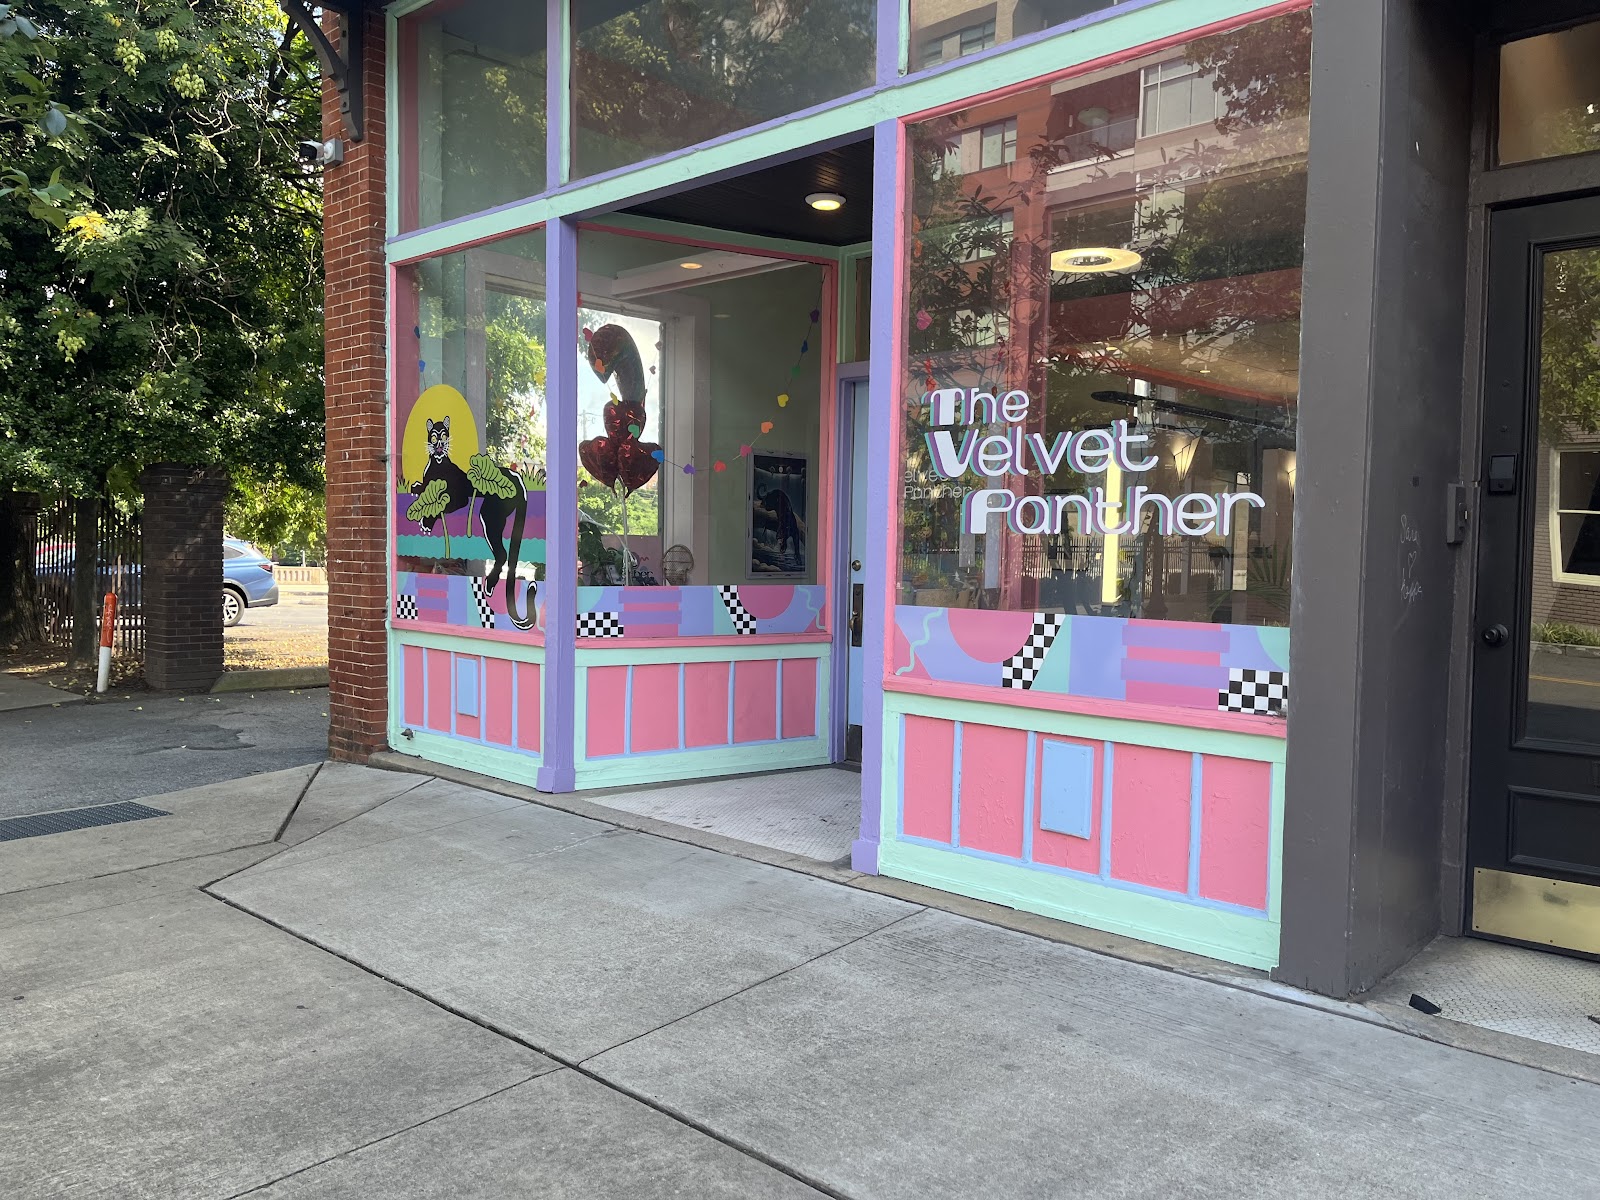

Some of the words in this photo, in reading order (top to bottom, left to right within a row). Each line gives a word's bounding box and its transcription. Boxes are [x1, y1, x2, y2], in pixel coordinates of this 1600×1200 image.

[921, 388, 1030, 426] The
[924, 419, 1159, 478] Velvet
[961, 486, 1265, 537] Panther
